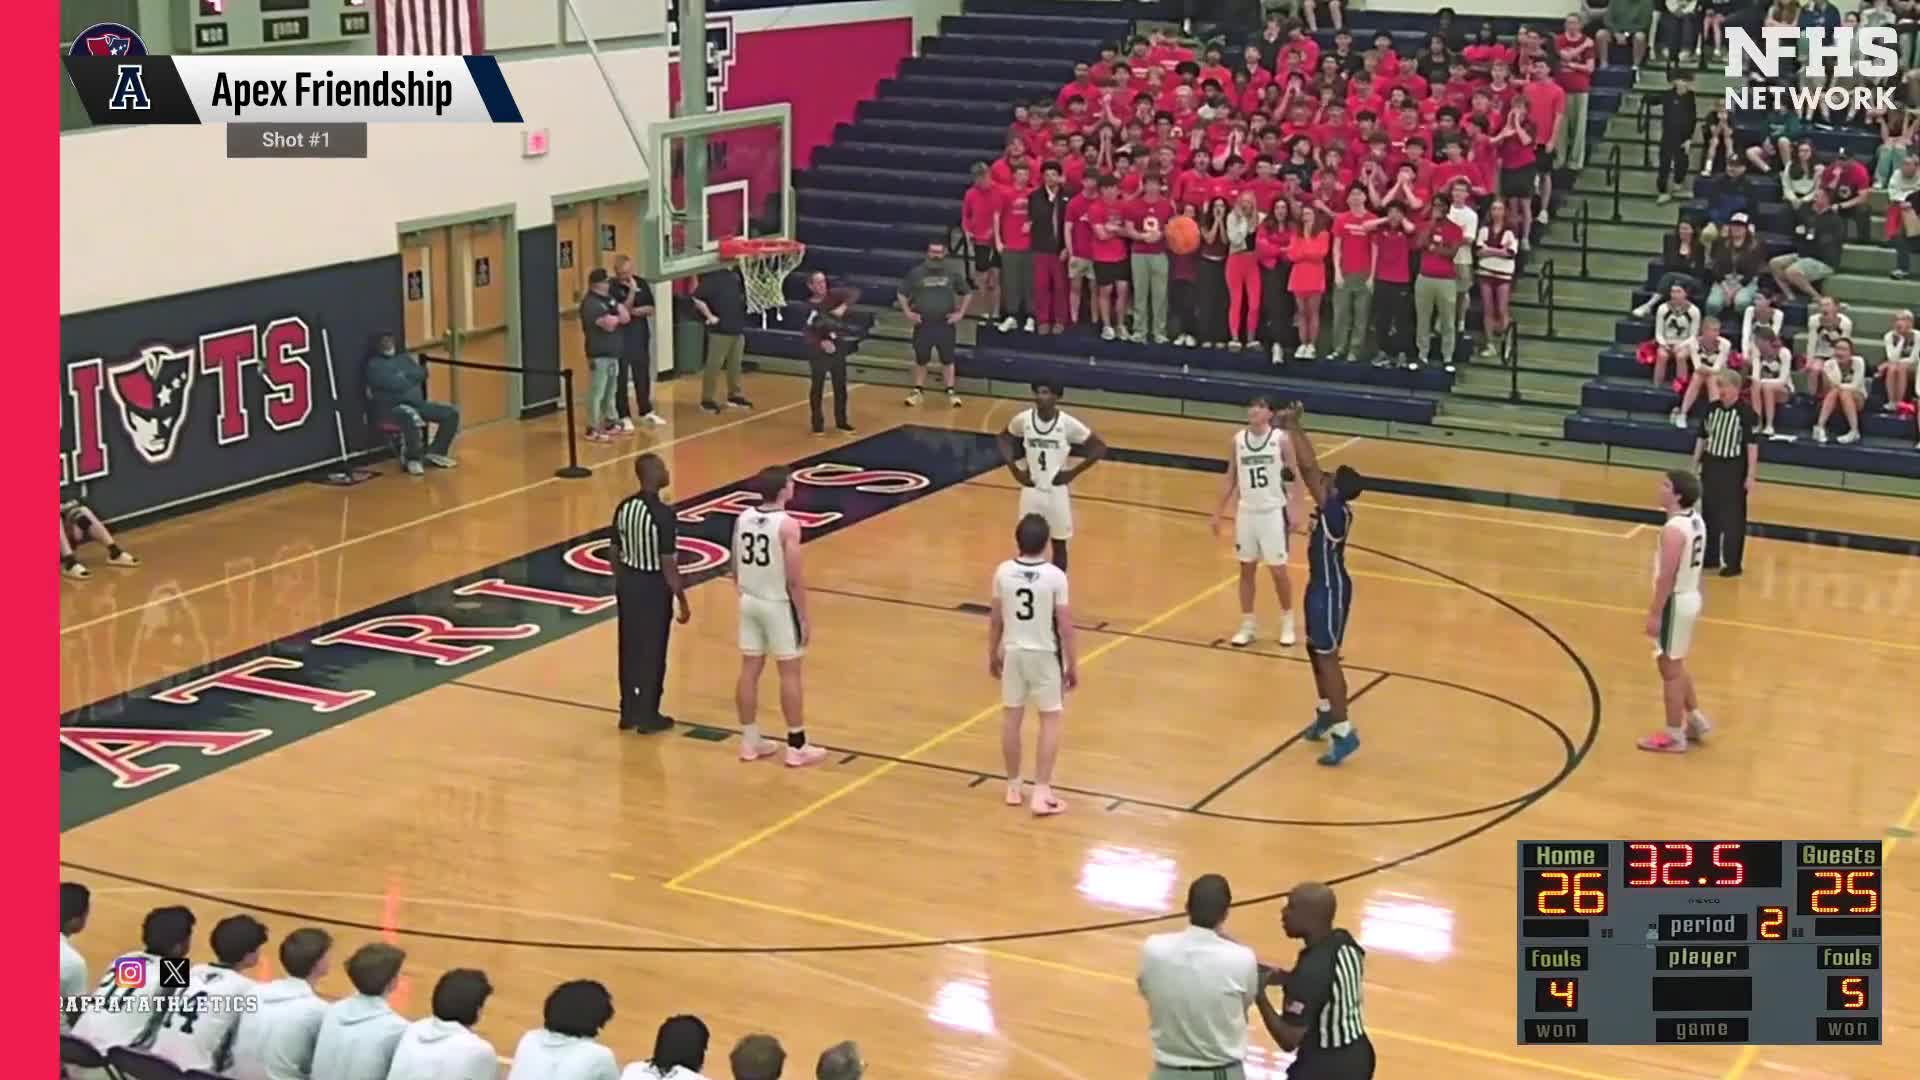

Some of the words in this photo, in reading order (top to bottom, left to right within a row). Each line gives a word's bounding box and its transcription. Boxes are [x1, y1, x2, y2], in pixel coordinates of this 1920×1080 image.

[1248, 466, 1269, 489] 15
[741, 532, 770, 567] 33
[1015, 588, 1034, 621] 3
